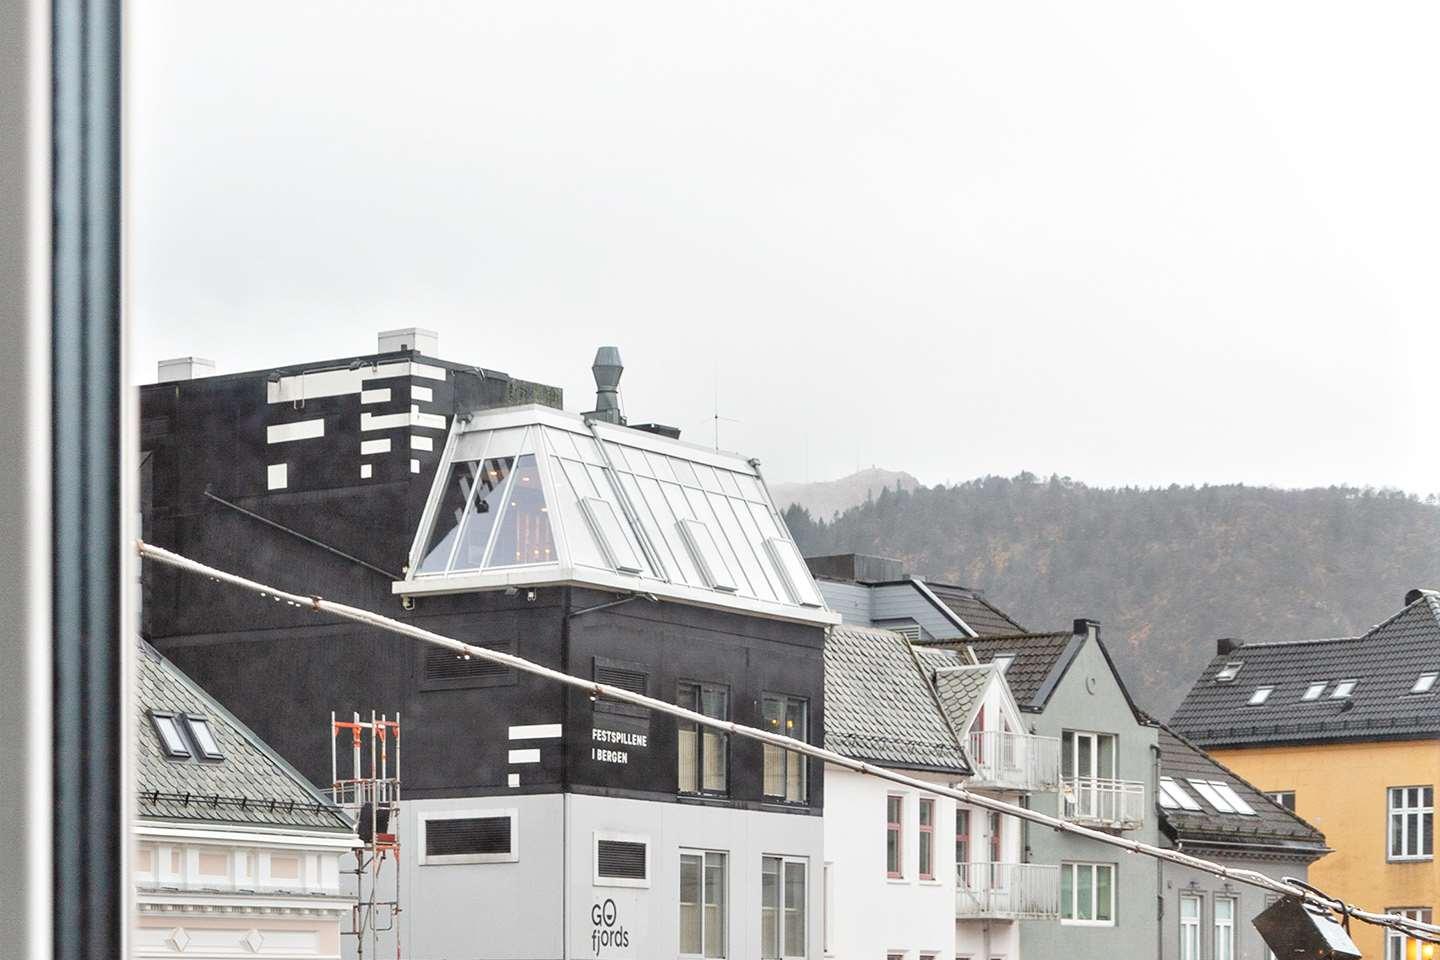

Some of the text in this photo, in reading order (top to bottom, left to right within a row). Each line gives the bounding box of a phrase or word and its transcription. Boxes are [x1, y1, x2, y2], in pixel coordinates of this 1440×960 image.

[592, 728, 647, 747] FESTSPILLENE
[597, 749, 628, 764] BERGEN
[591, 899, 616, 927] GO
[592, 926, 629, 957] fjords
